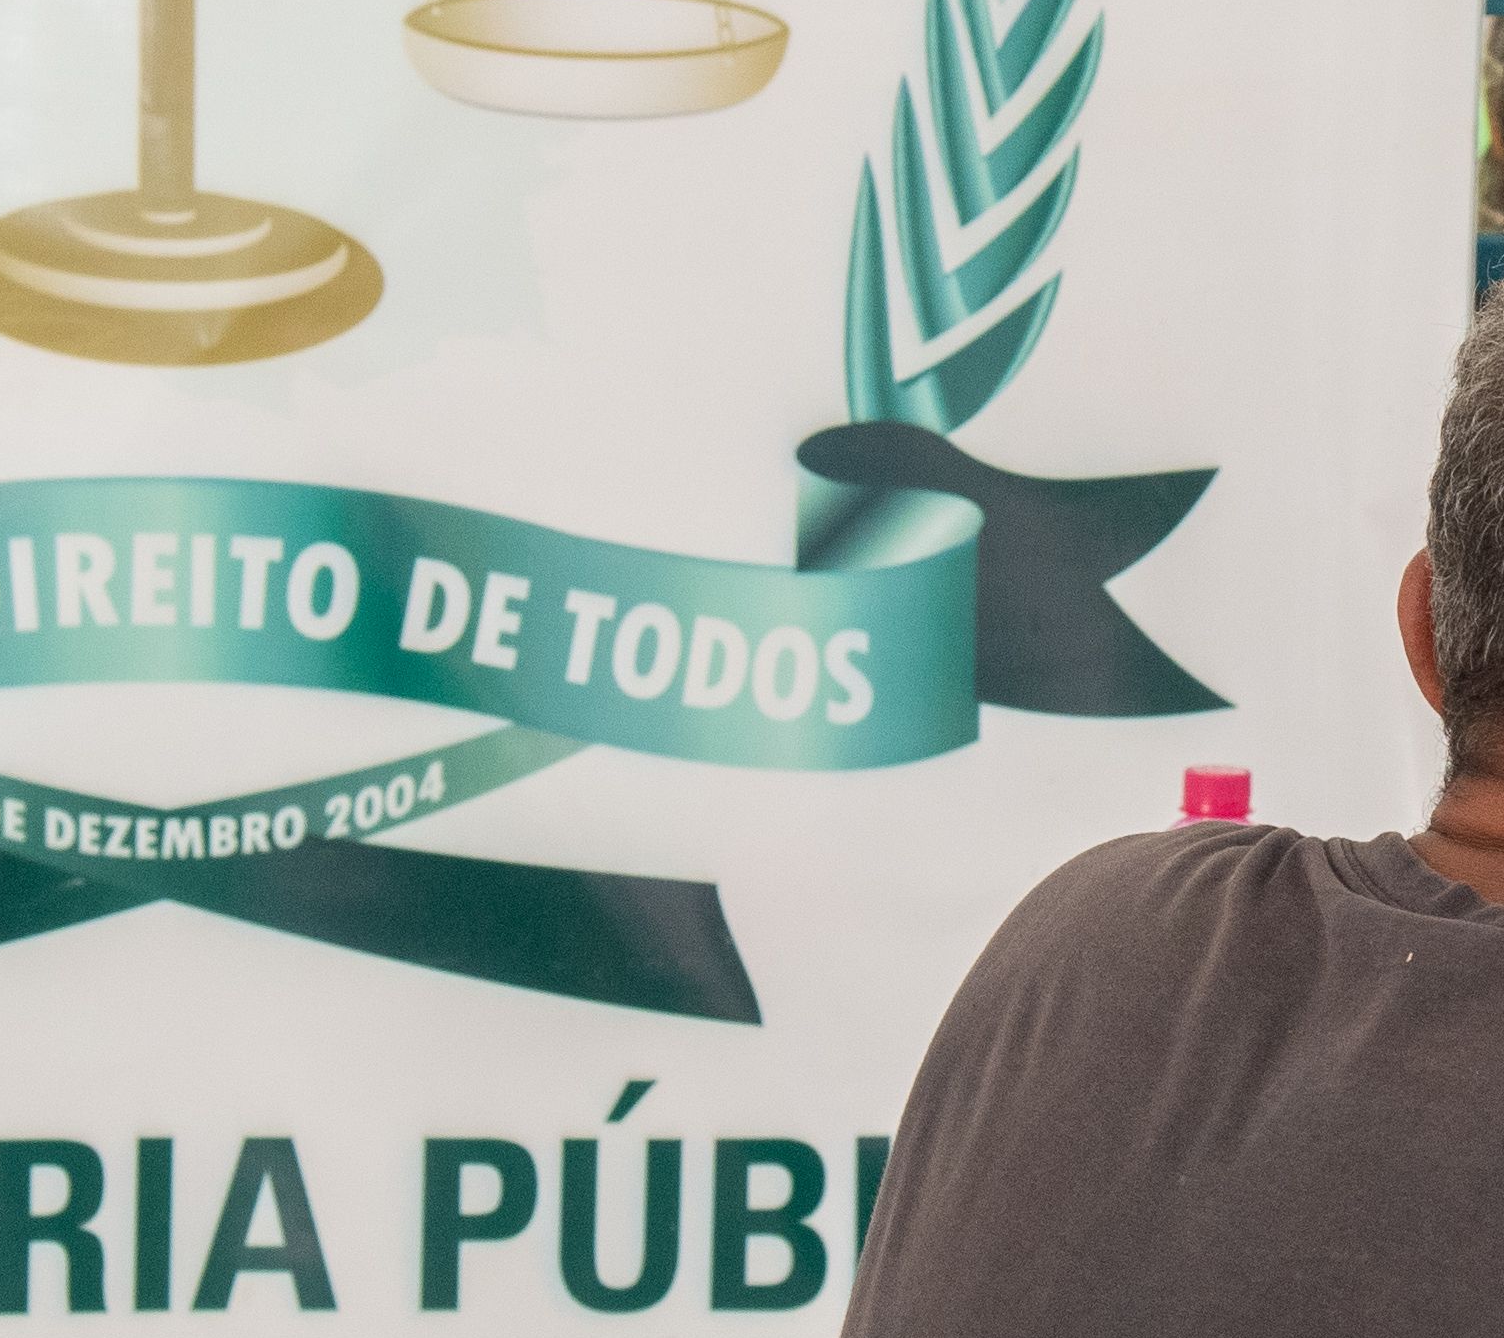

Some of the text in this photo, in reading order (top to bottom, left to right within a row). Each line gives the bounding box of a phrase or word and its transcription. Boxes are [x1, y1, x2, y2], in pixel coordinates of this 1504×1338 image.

[398, 558, 529, 669] DE
[563, 587, 875, 728] TODOS
[43, 804, 308, 861] DEZEMBRO
[323, 759, 447, 840] 2004
